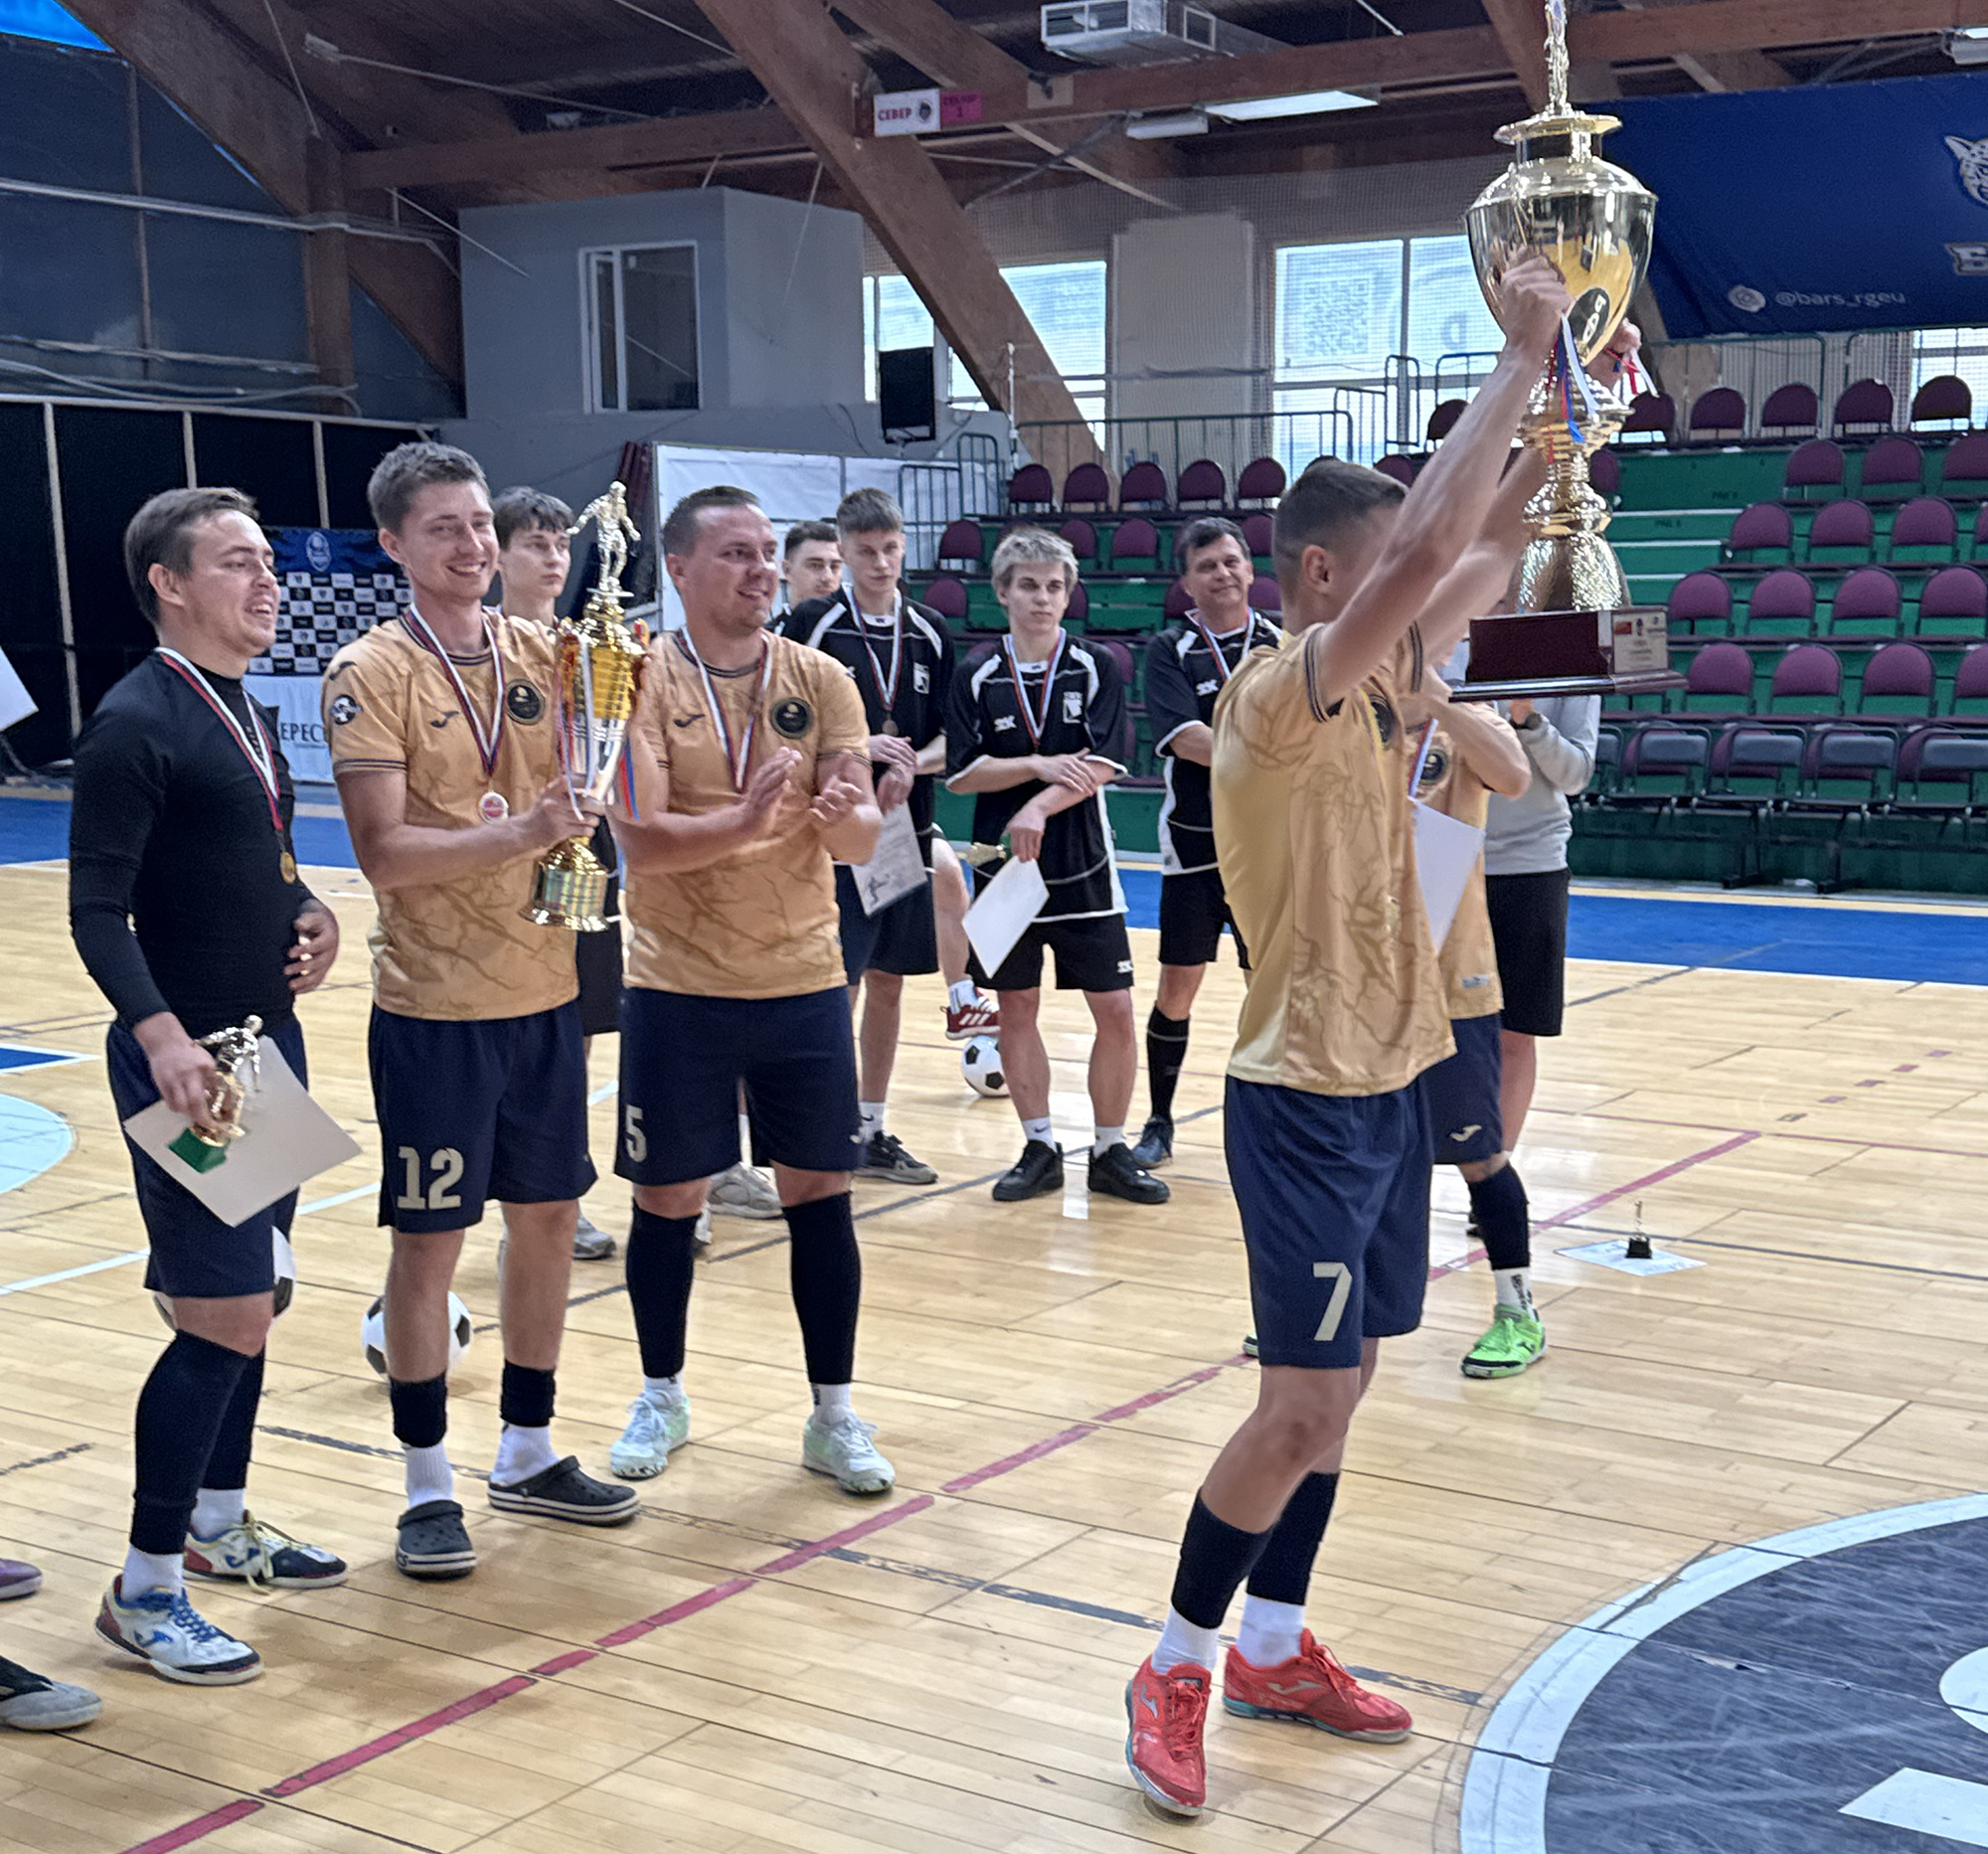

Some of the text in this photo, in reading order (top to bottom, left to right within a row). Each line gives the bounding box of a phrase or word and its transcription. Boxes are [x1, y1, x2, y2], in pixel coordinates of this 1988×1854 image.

[878, 107, 912, 121] СЕВЕР
[1774, 291, 1905, 308] @bars_rgeu
[625, 1103, 647, 1162] 5
[398, 1145, 464, 1210] 12
[1313, 1262, 1353, 1341] 7
